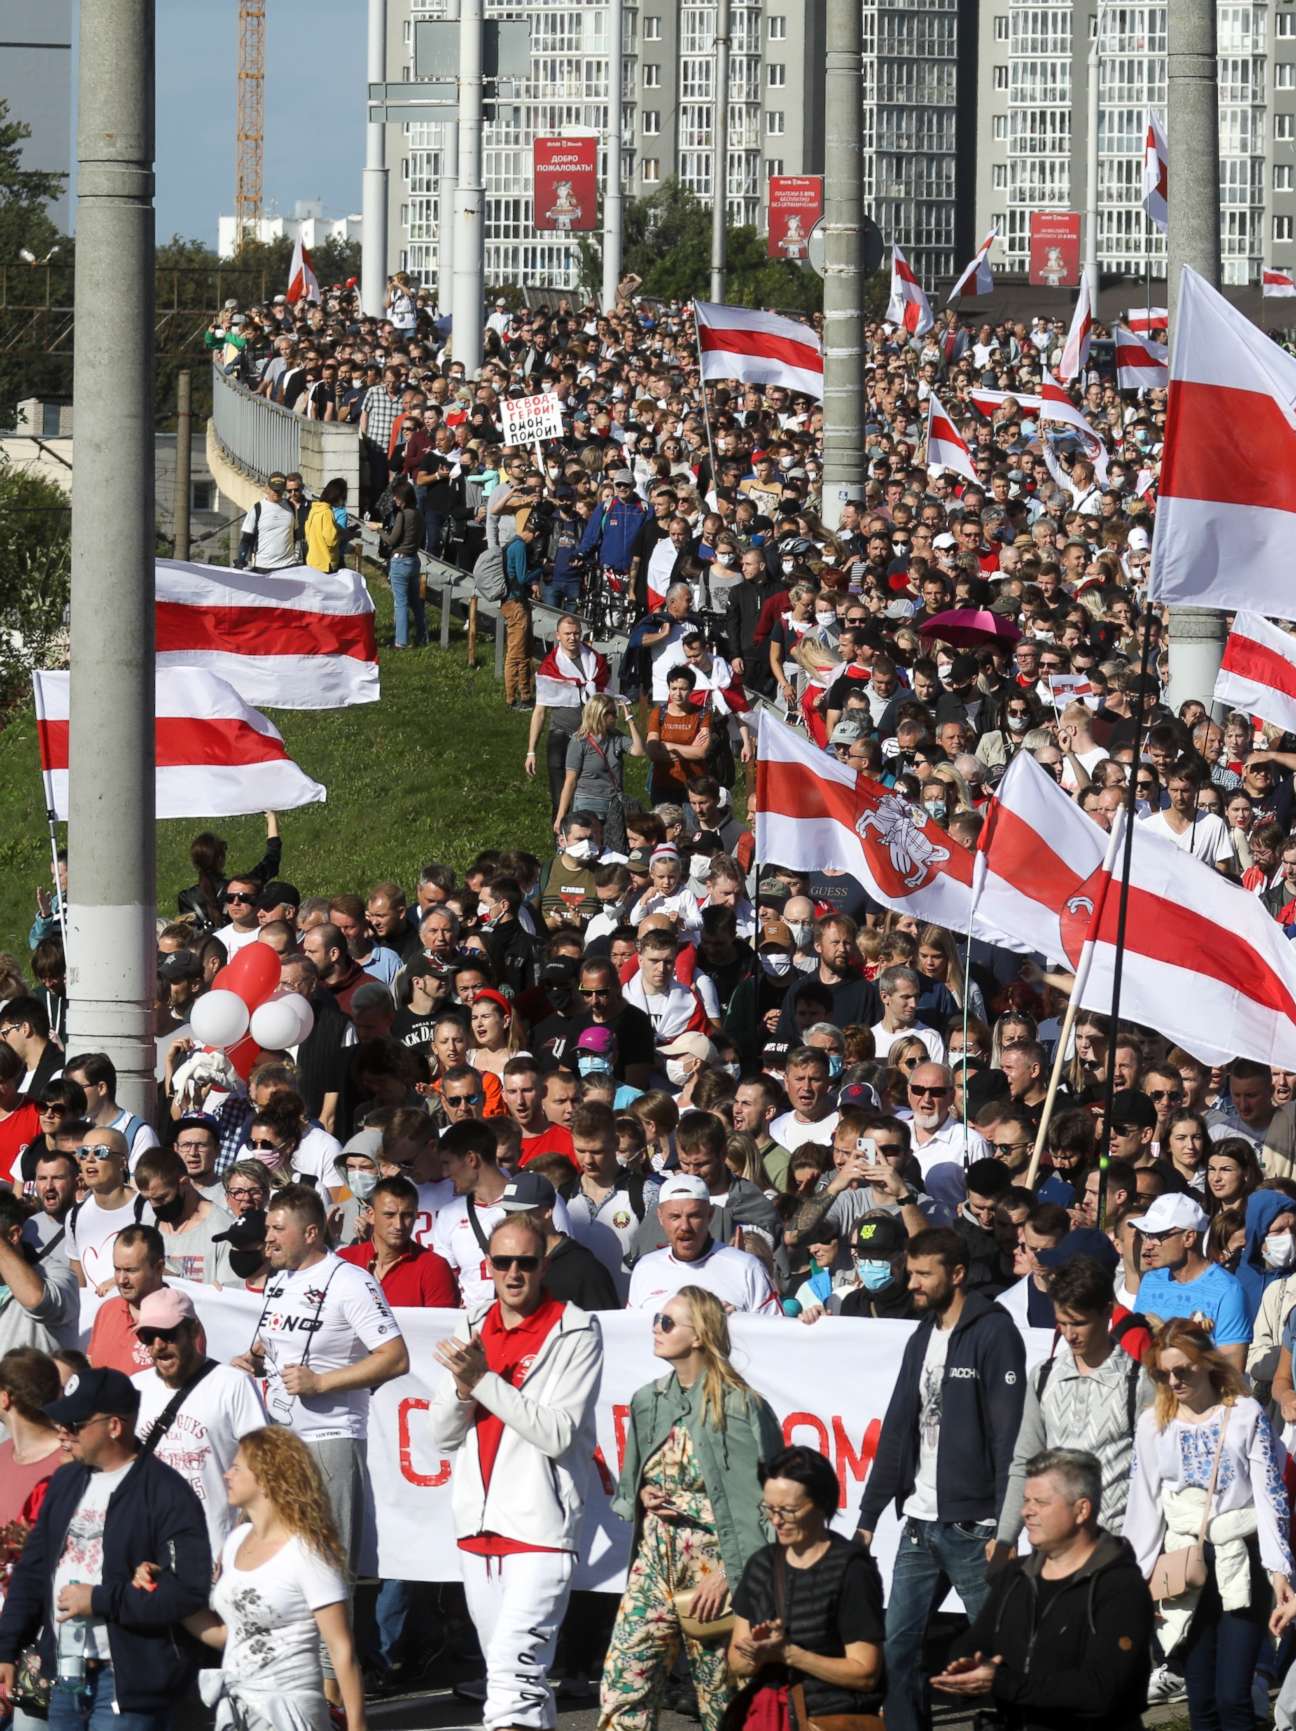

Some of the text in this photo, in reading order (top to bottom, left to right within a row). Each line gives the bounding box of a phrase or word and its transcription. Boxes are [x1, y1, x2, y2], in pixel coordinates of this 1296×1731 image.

[552, 155, 578, 163] ДОБРО
[536, 164, 593, 172] ПОЖАЛОВАТЬ!
[810, 886, 849, 897] GUESS
[949, 1367, 980, 1379] ACCH
